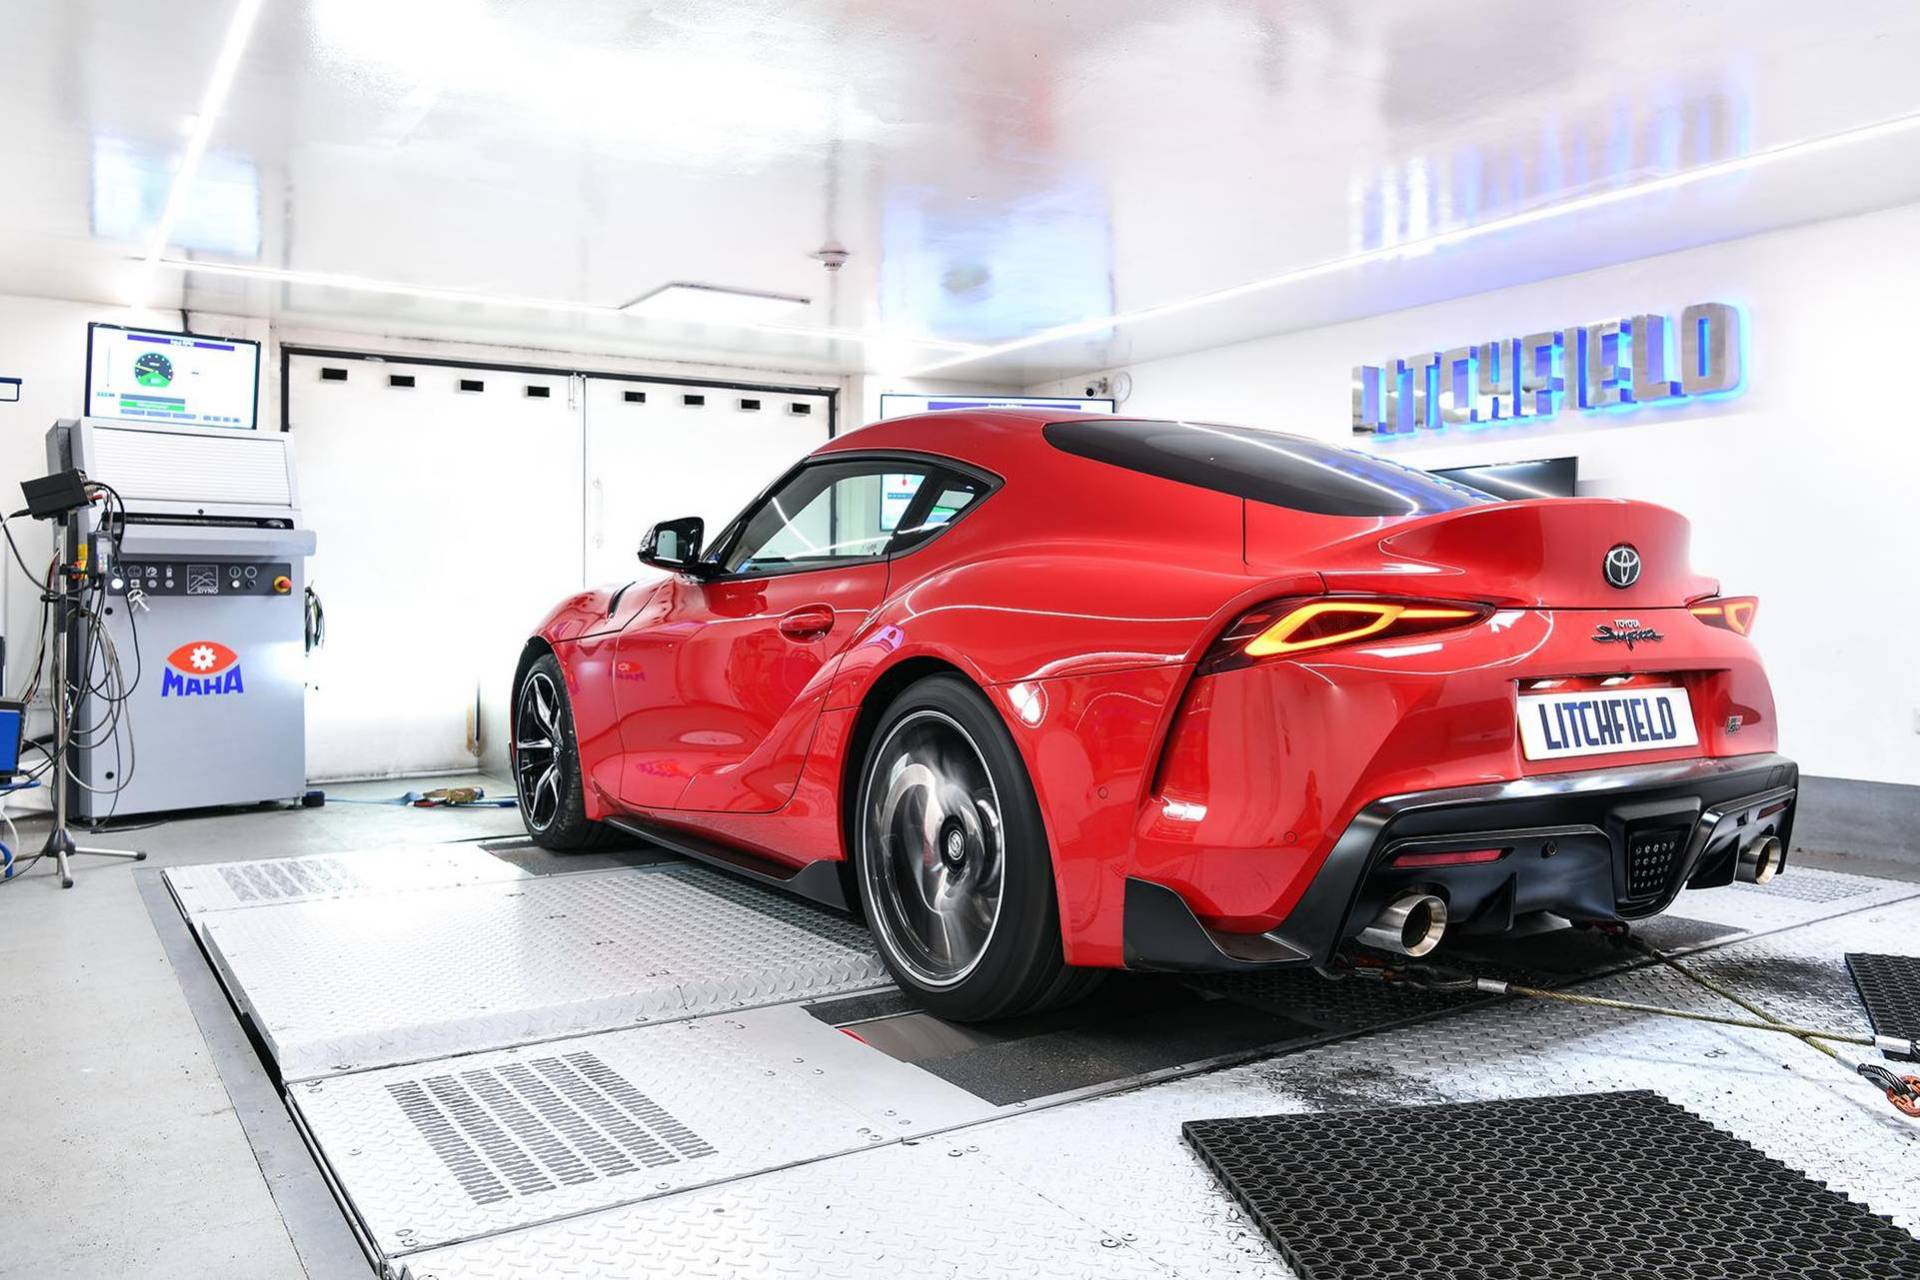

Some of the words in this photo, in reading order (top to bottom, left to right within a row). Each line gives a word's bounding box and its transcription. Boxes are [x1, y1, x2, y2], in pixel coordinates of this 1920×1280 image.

[1352, 302, 1741, 437] LITCHFIELD
[1591, 624, 1665, 651] Supra
[161, 664, 244, 697] MAHA
[1538, 697, 1677, 750] LITCHFIELD
